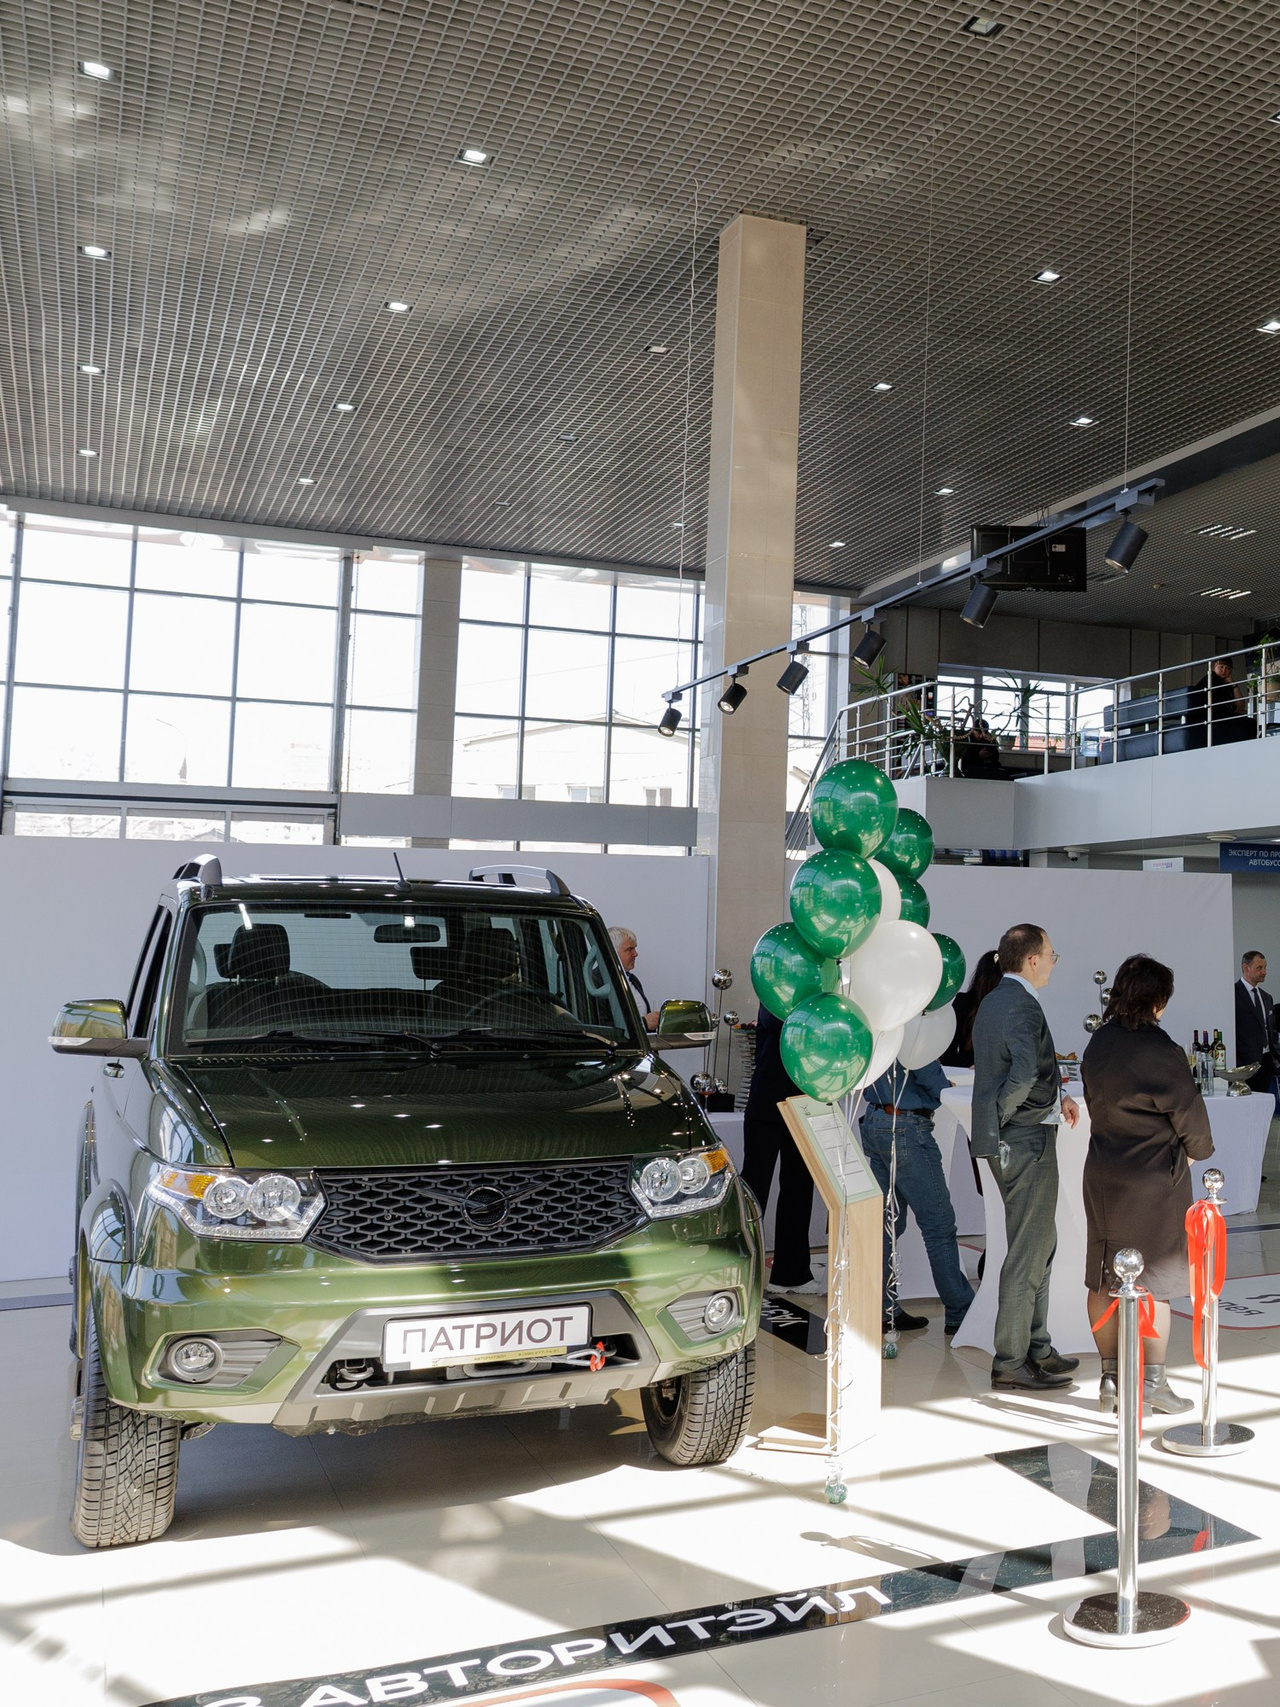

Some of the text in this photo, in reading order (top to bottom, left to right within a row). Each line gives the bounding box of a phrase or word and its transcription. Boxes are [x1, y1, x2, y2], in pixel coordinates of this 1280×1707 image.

[1228, 849, 1258, 858] ЭКСПЕРТ
[1259, 850, 1269, 858] ПО
[402, 1315, 574, 1355] ПАТРИОТ
[299, 1585, 893, 1707] АВТОРИТЭЙЛ
